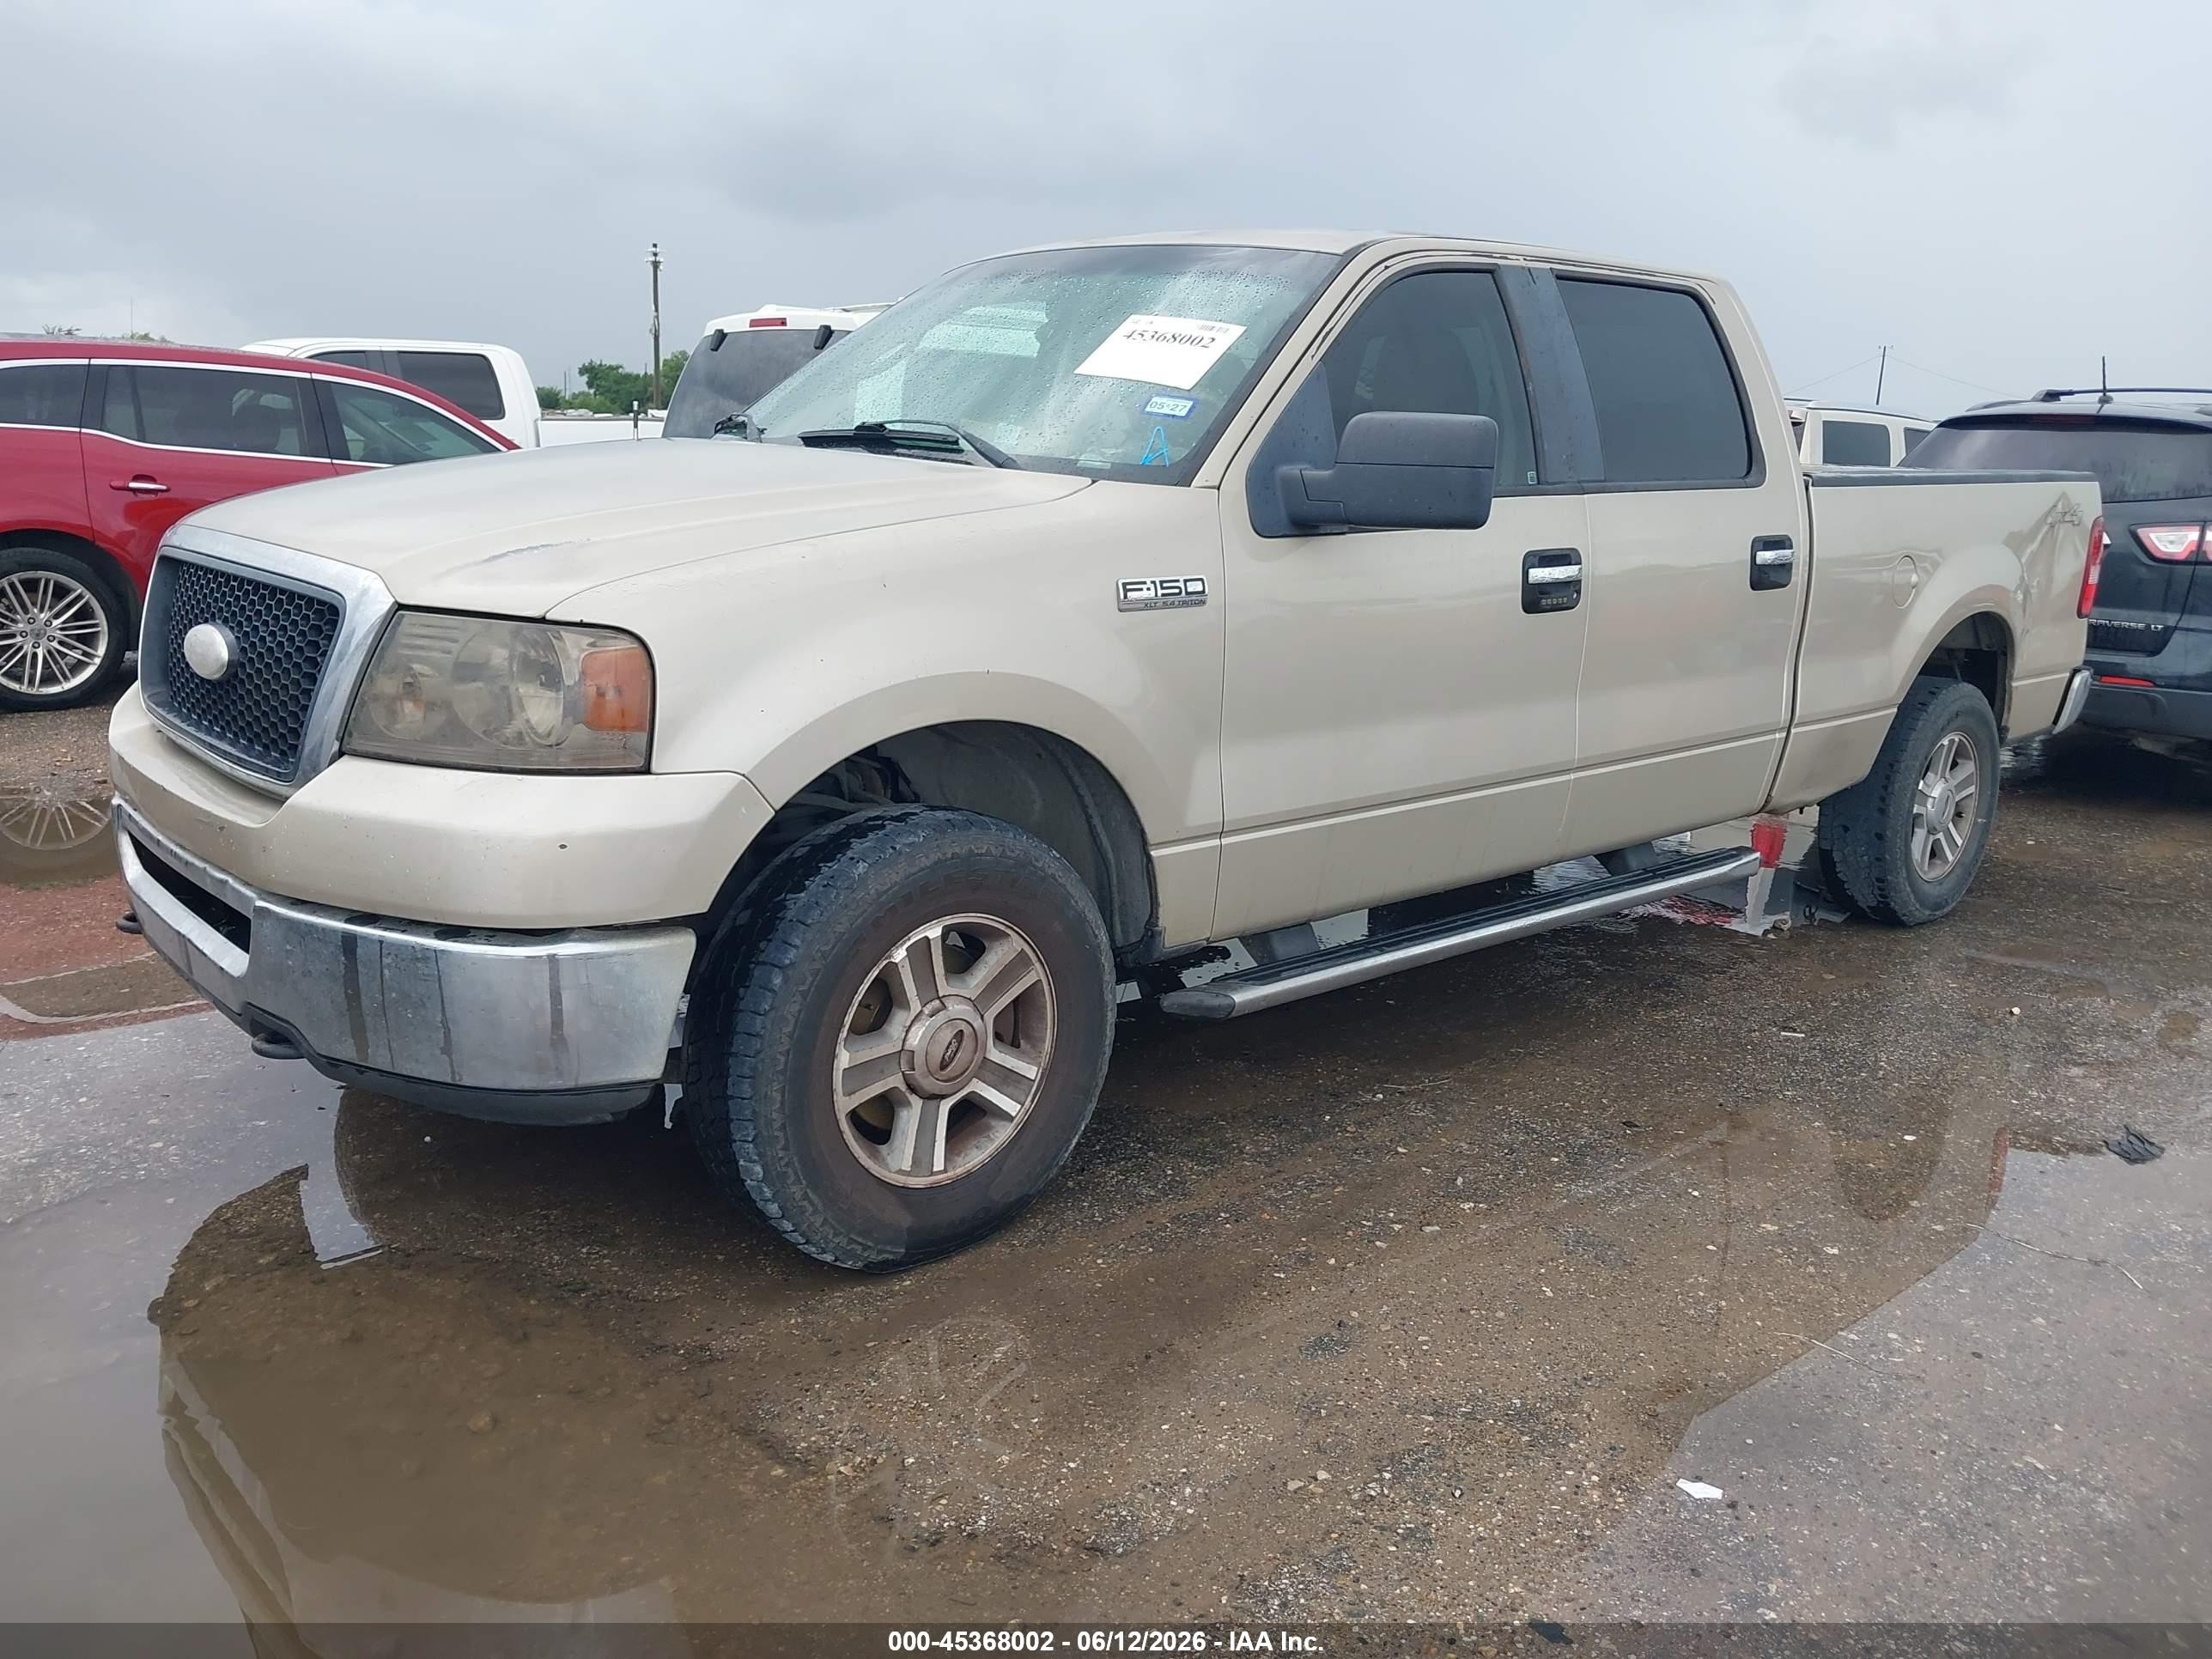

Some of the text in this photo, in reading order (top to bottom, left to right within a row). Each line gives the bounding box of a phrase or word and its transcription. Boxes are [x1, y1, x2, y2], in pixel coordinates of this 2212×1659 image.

[1123, 329, 1217, 349] 45368002
[1140, 426, 1169, 467] A
[1176, 599, 1206, 607] TRITON
[2088, 619, 2147, 630] RAVERSE
